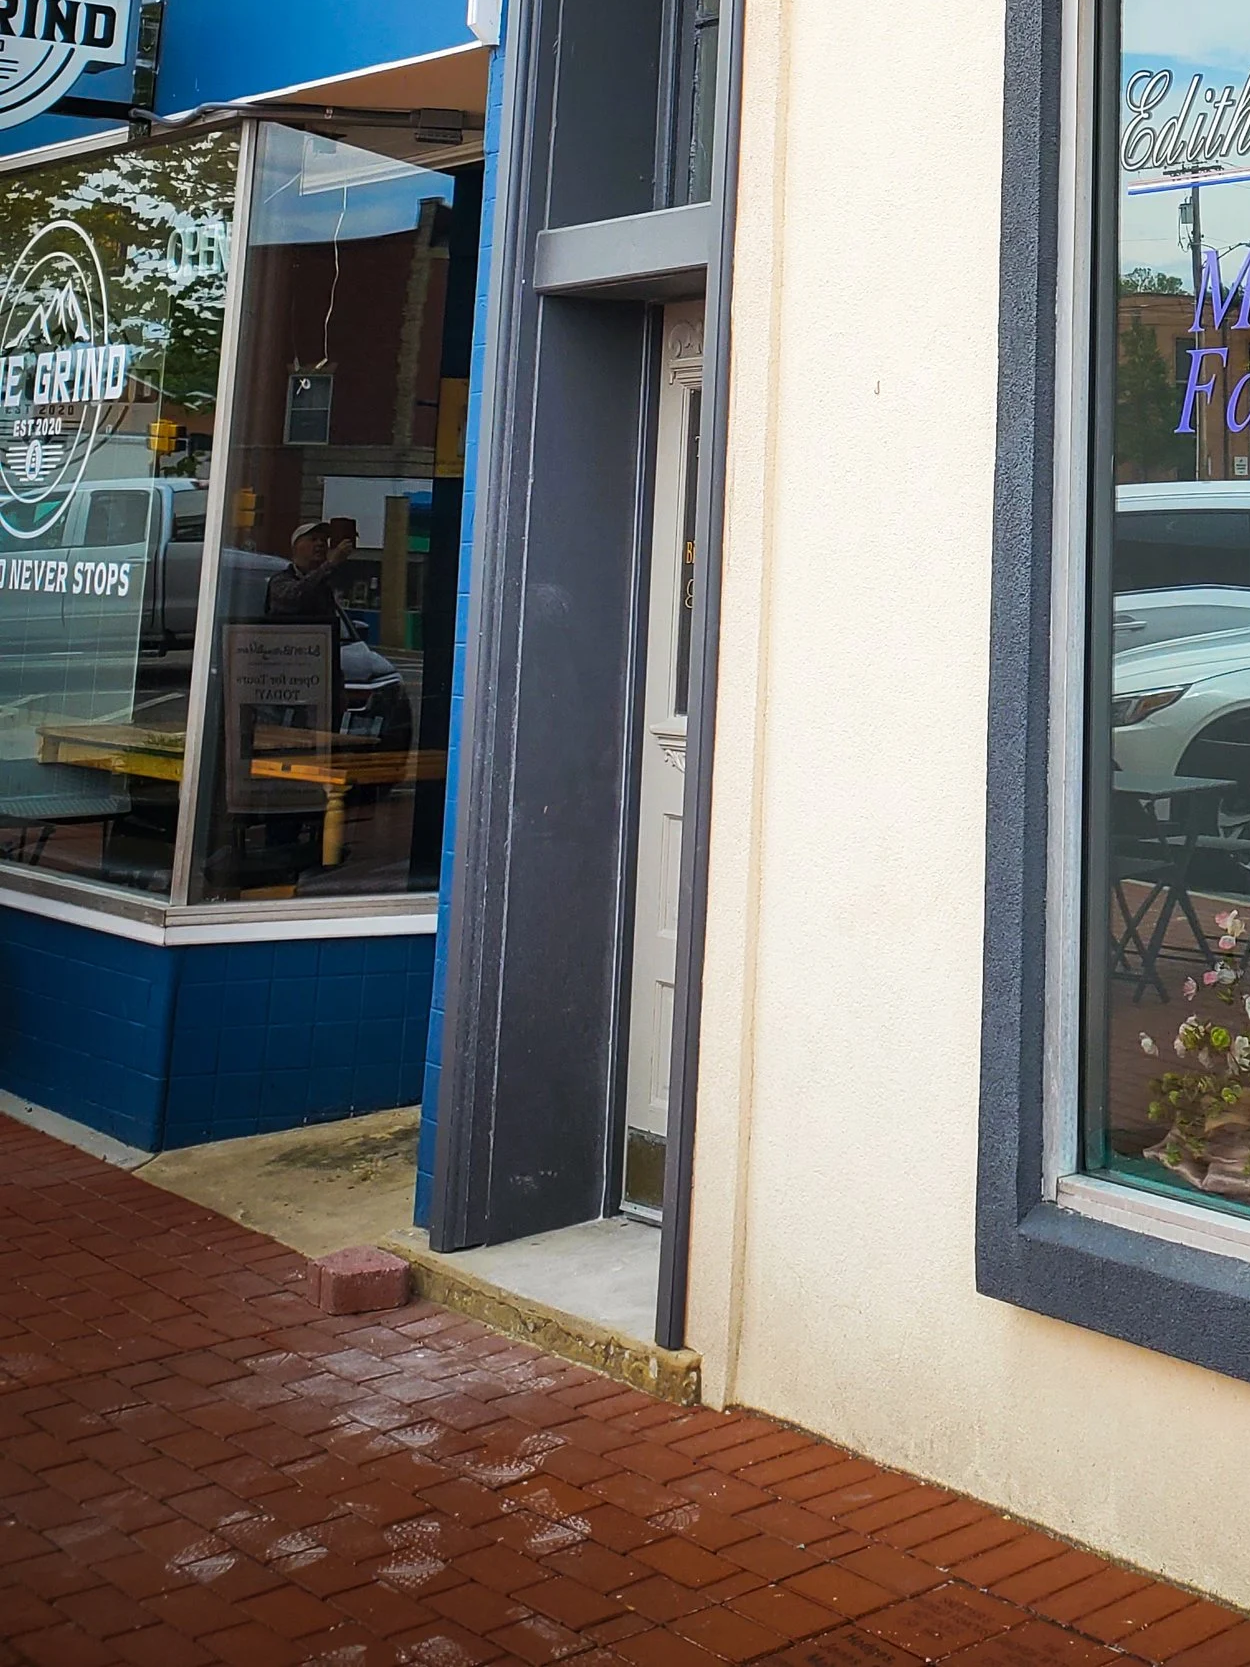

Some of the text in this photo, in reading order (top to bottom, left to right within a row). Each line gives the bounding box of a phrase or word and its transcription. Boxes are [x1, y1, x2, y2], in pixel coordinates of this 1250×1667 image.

[33, 344, 126, 406] GRIND
[13, 417, 62, 437] EST 2020
[8, 558, 69, 593] NEVER
[72, 561, 131, 597] STOPS
